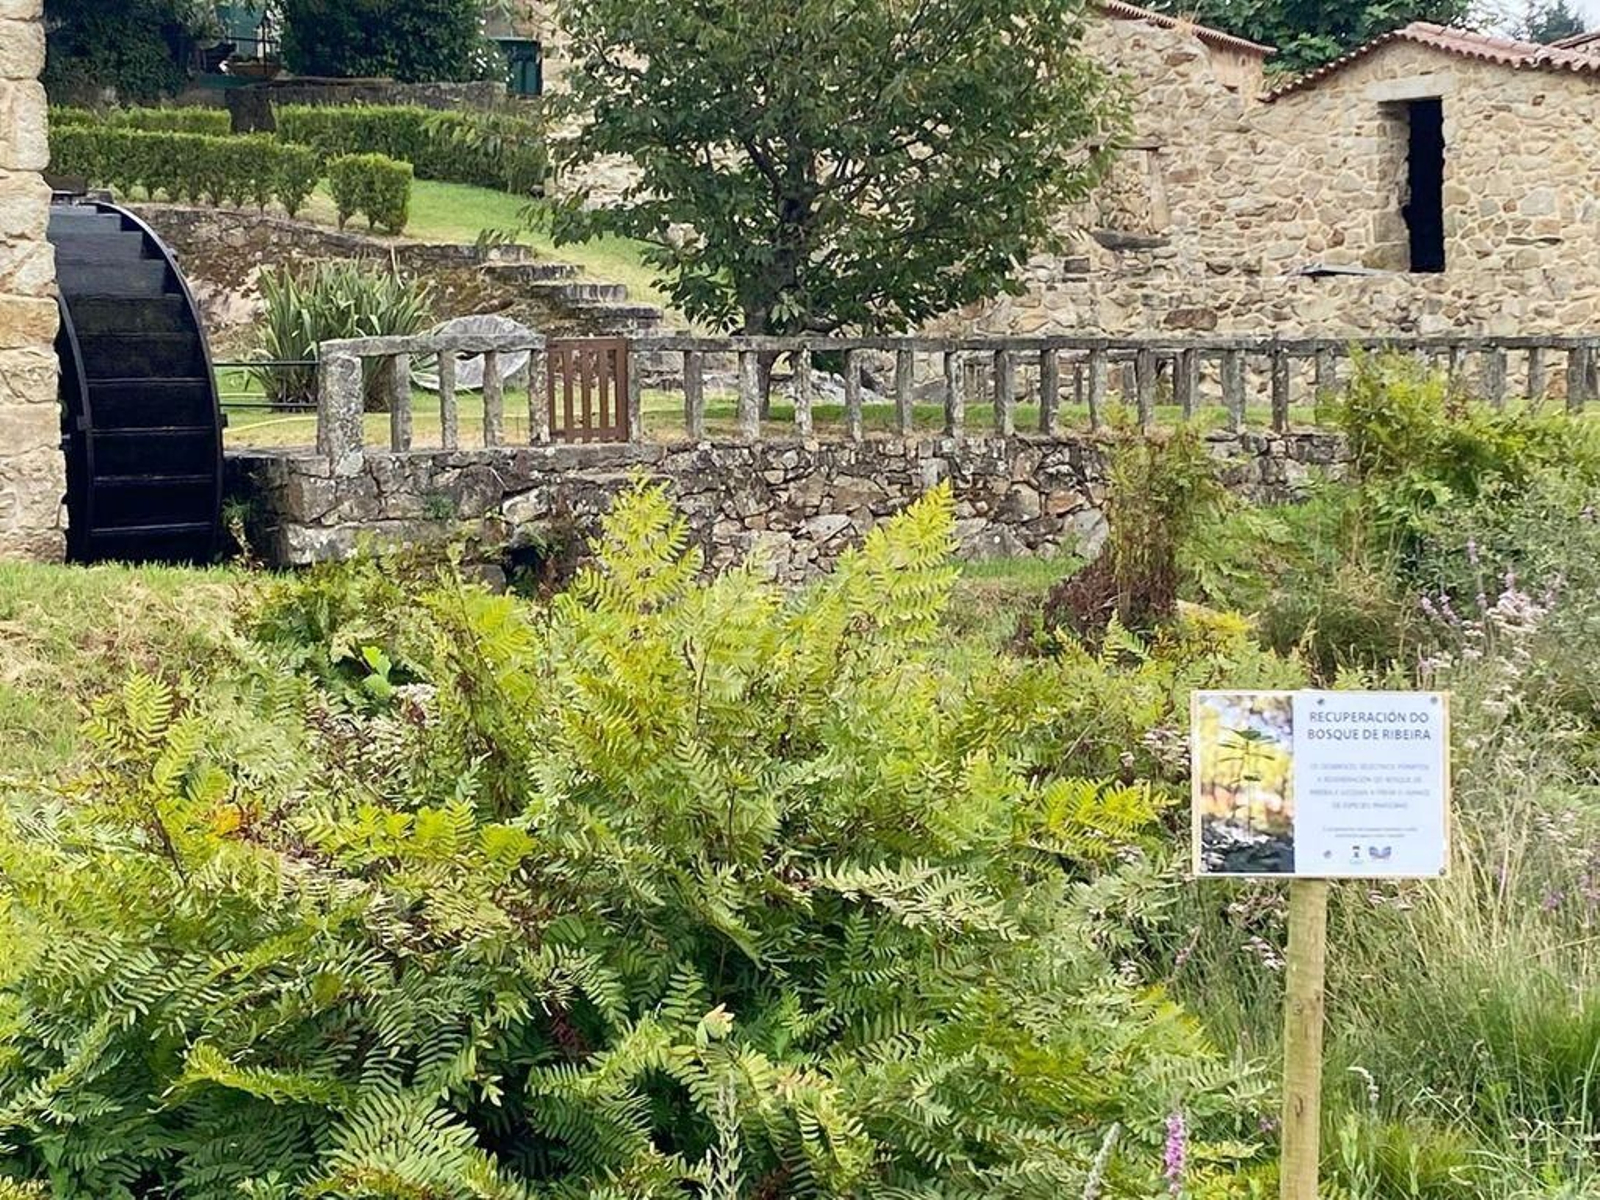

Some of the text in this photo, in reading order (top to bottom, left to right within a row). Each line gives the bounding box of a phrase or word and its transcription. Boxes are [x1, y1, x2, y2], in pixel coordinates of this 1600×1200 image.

[1309, 709, 1429, 723] RECUPERACIÓN DO
[1307, 728, 1432, 741] BOSQUE DE RIBEIRA
